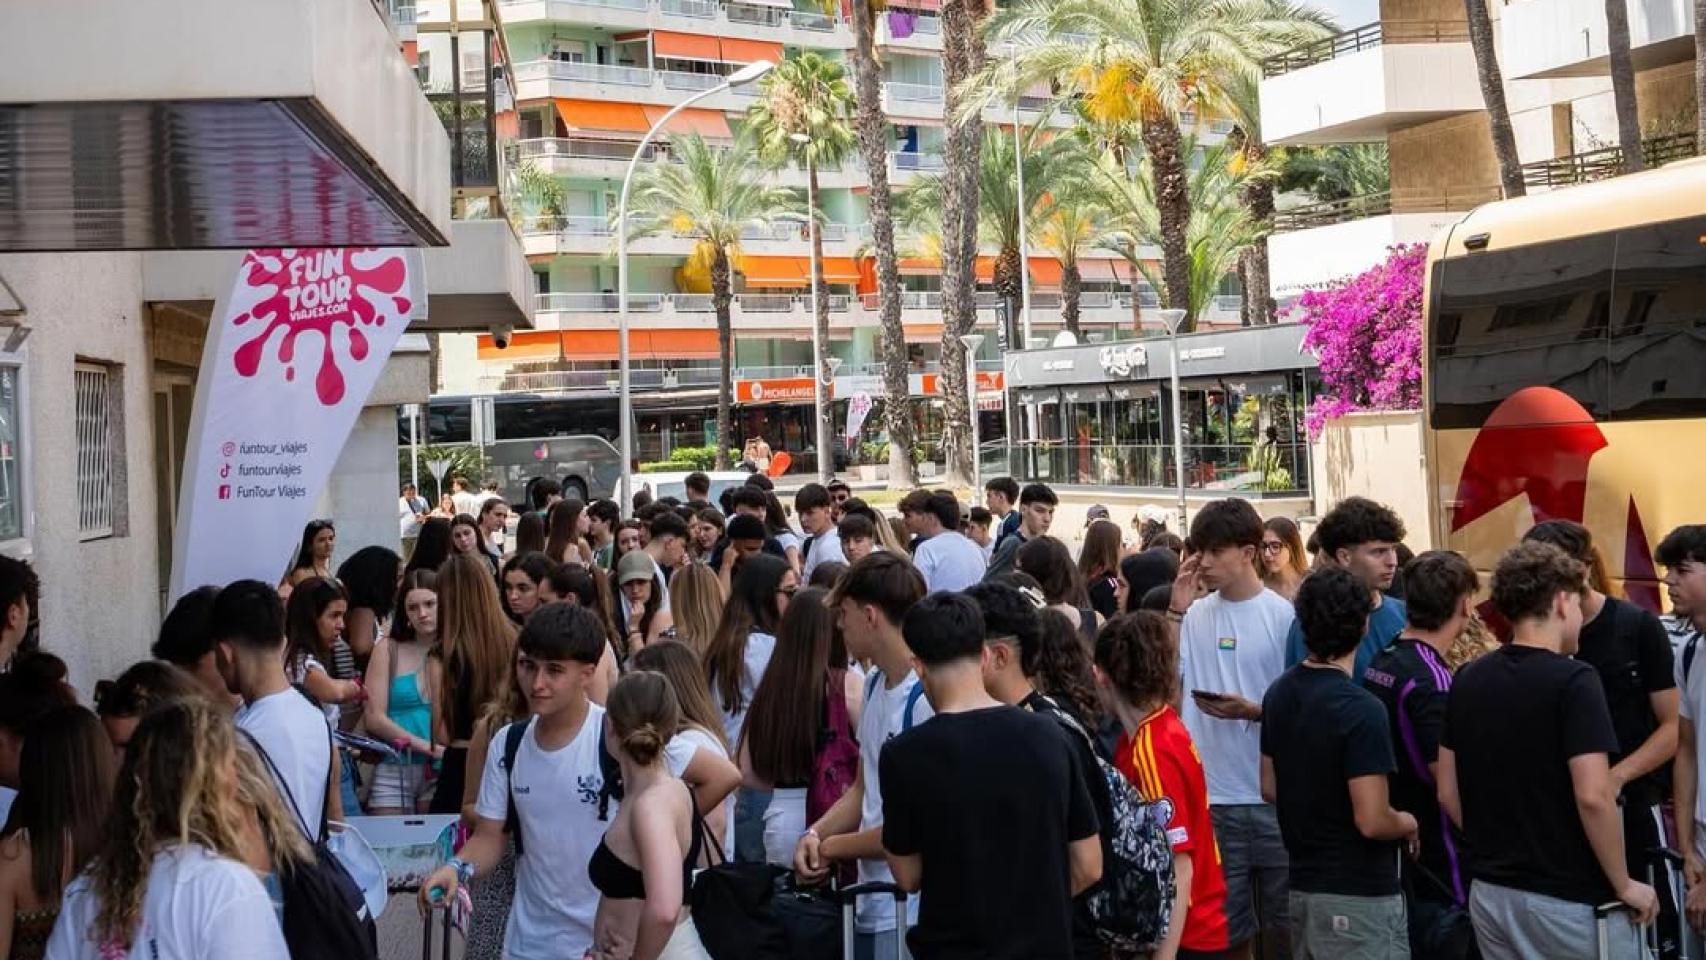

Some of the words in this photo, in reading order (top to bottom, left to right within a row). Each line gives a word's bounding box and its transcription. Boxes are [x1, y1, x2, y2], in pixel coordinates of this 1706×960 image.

[289, 248, 344, 285] FUN
[283, 275, 352, 311] TOUR
[290, 302, 349, 322] VIAJES.COM
[240, 441, 308, 456] funtour_viajes
[239, 463, 303, 478] funtourviajes
[237, 485, 276, 498] FunTour
[278, 485, 306, 500] Viajes
